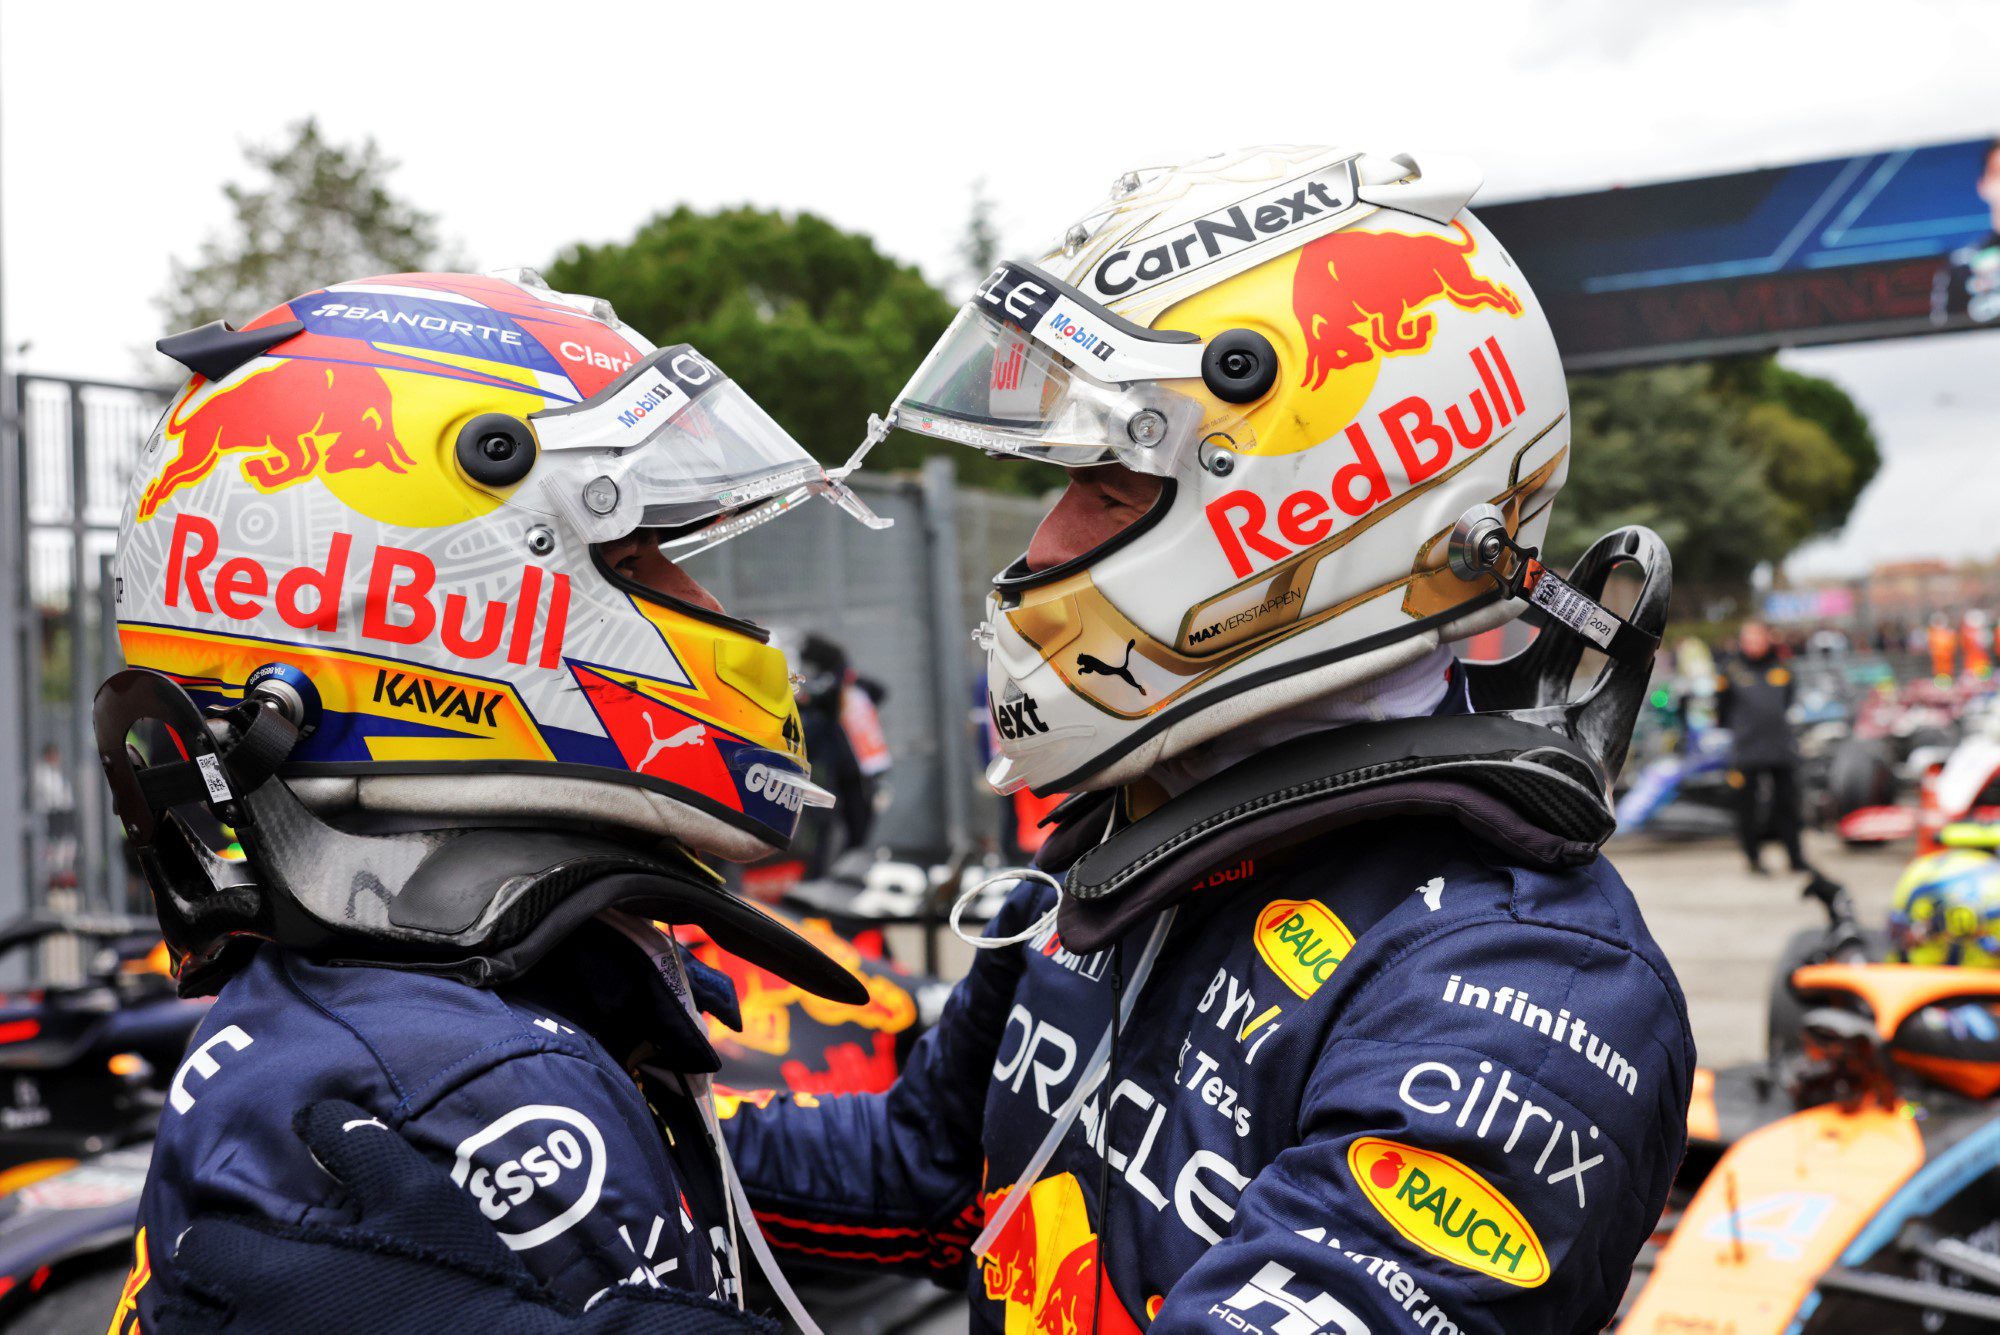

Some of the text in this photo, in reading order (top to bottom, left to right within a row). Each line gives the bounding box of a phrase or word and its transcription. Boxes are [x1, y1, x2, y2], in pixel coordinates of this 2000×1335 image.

[1095, 178, 1342, 296] CarNext
[343, 307, 522, 346] BANORTE
[1050, 312, 1099, 350] Mobil
[617, 392, 661, 429] Mobil
[1205, 337, 1526, 579] Red Bull
[164, 513, 571, 670] Red Bull
[1589, 617, 1611, 637] 2021
[373, 669, 504, 728] KAVAK
[1442, 975, 1639, 1096] infinitum
[1399, 1061, 1604, 1209] citrix
[1397, 1169, 1528, 1280] RAUCH
